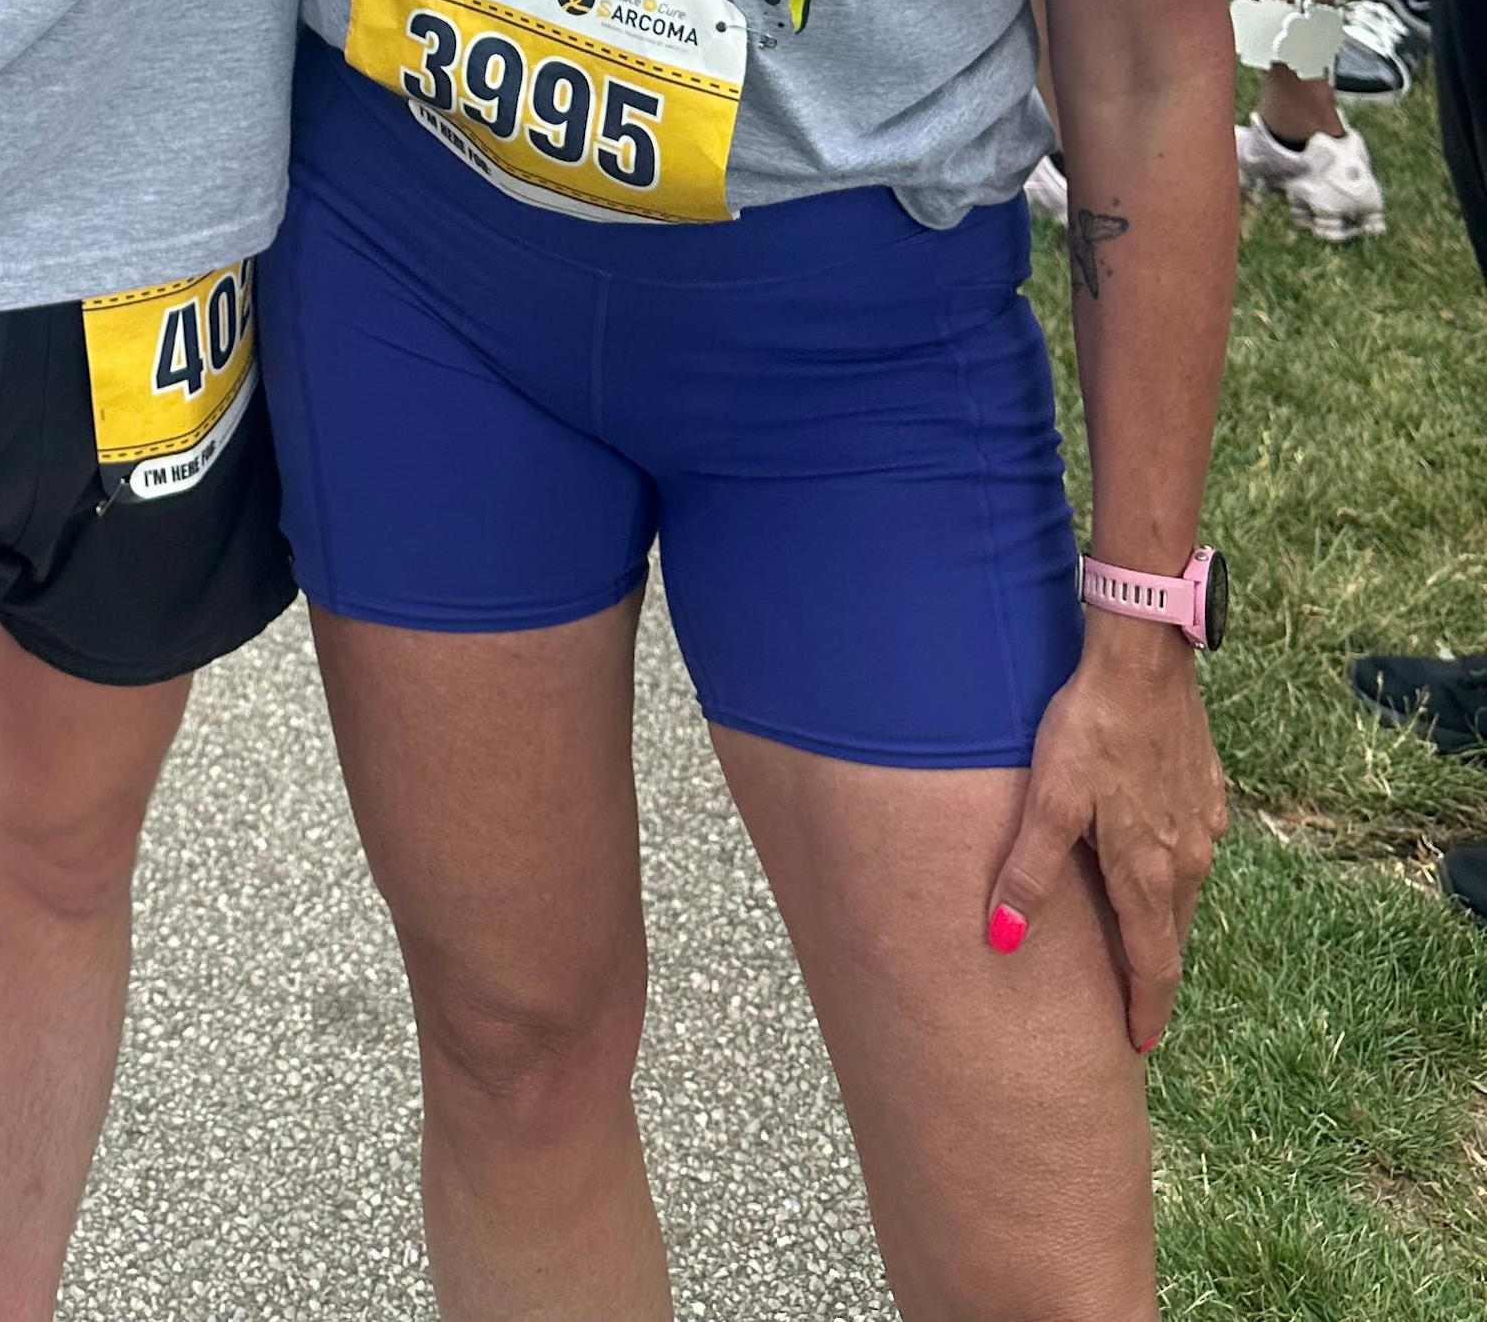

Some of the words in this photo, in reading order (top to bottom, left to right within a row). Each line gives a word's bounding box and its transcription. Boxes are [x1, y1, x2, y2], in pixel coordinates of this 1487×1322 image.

[596, 0, 698, 46] SARCOMA
[657, 3, 686, 20] Cure
[401, 10, 663, 189] 3995
